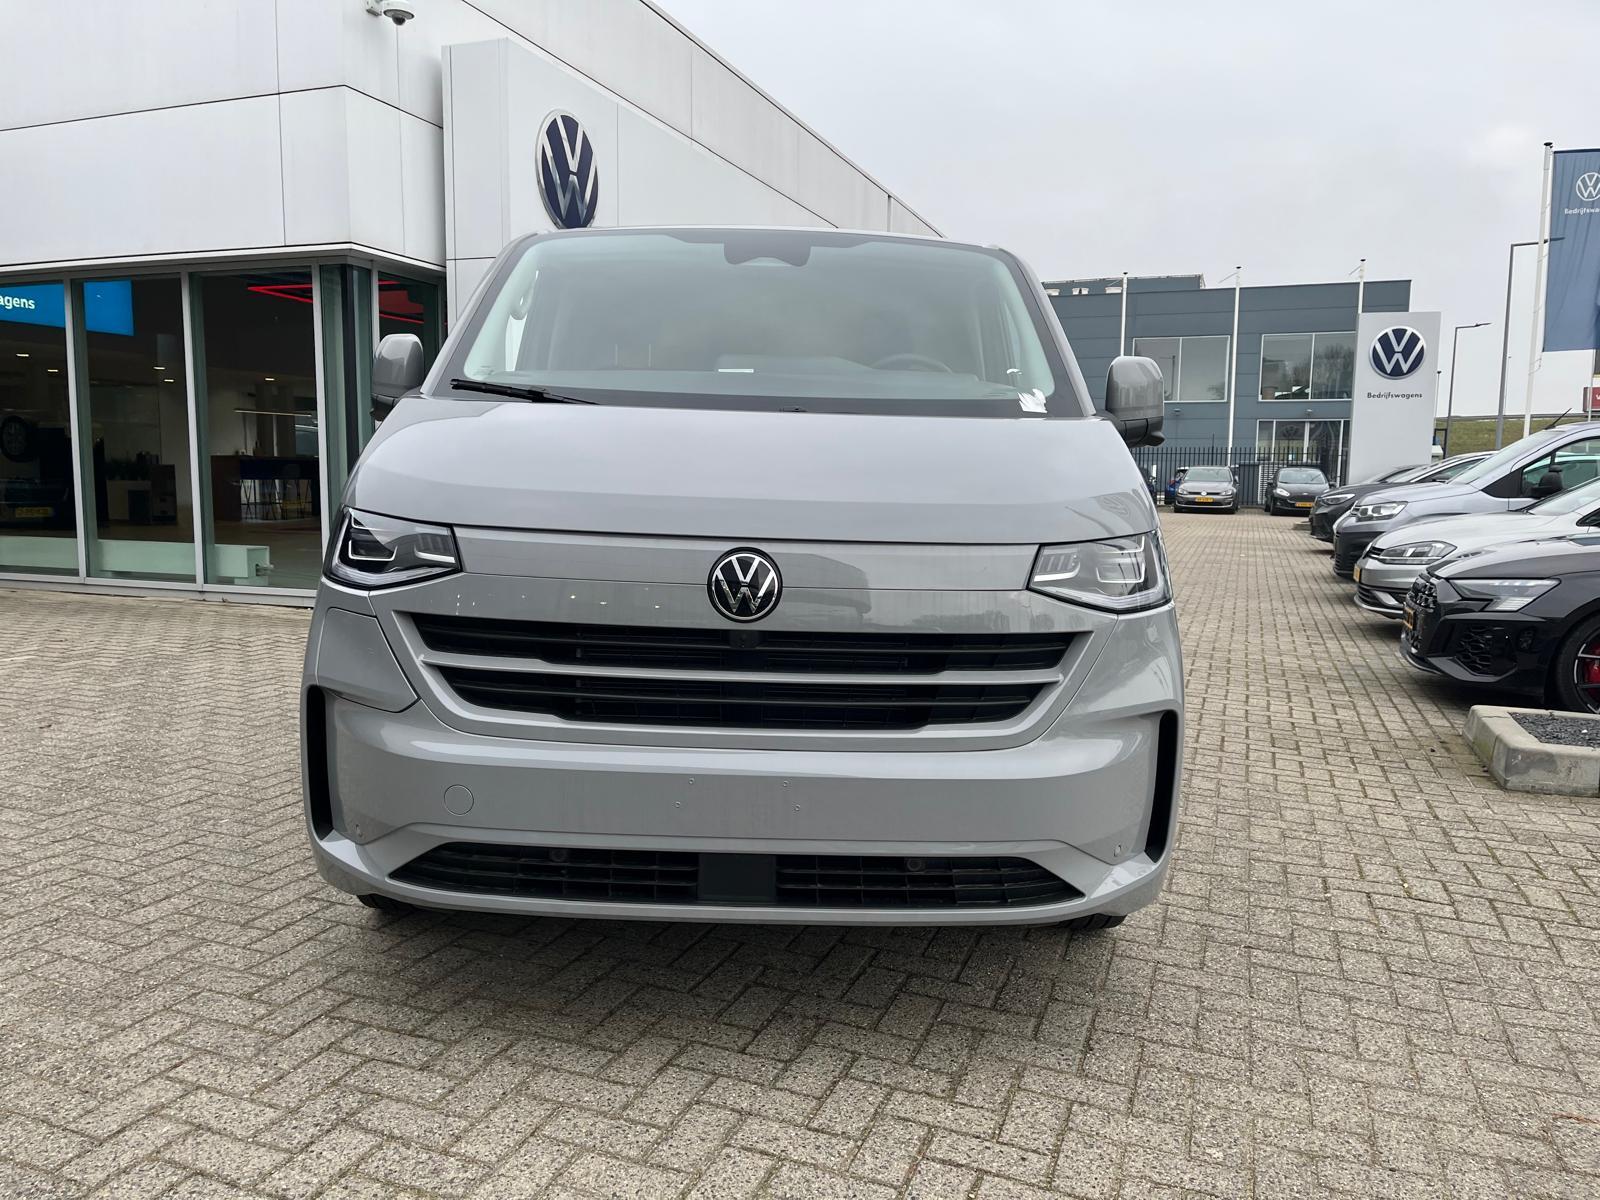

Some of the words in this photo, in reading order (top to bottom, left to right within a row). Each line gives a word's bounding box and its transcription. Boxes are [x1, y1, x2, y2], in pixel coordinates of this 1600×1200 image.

[1371, 327, 1425, 378] VW
[1366, 391, 1423, 400] Bedrijfswagens
[711, 553, 779, 620] VW
